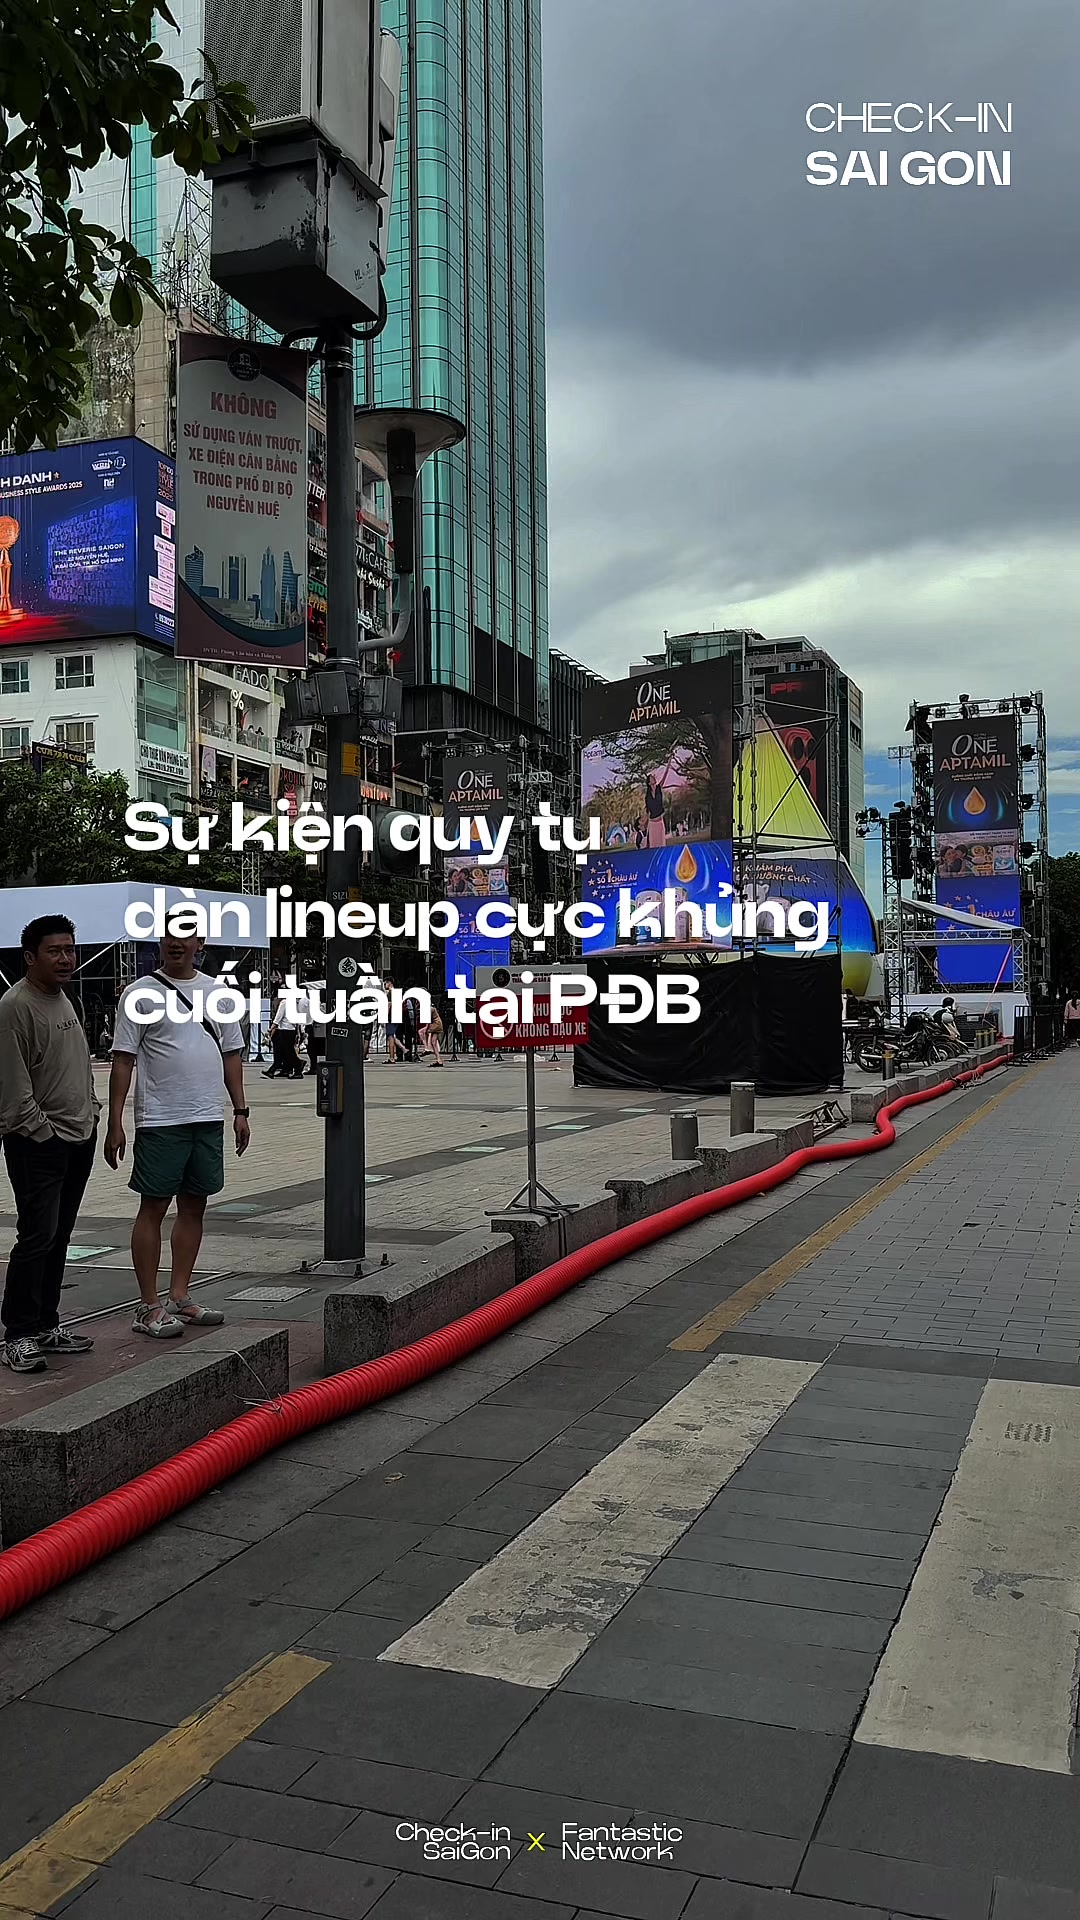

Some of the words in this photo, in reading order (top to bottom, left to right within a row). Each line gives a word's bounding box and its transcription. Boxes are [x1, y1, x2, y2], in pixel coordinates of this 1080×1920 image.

[211, 392, 277, 420] KHÔNG
[183, 420, 201, 439] SỬ
[202, 426, 235, 445] DỤNG
[238, 430, 262, 448] VÁN
[265, 435, 302, 455] TRƯỢT,
[188, 446, 204, 462] XE
[207, 448, 235, 468] ĐIỆN
[238, 452, 263, 470] CÂN
[266, 454, 298, 475] BẰNG
[12, 471, 52, 487] DANH
[25, 486, 42, 495] STYLE
[42, 482, 68, 493] AWARDS
[68, 480, 83, 489] 2025
[192, 470, 232, 489] TRONG
[235, 474, 260, 492] PHỐ
[262, 480, 274, 494] ĐI
[277, 480, 293, 499] BỘ
[206, 494, 254, 514] NGUYỄN
[257, 501, 280, 520] HUỆ
[98, 543, 125, 551] SAIGON
[637, 681, 671, 708] ONE
[628, 700, 681, 724] APTAMIL
[952, 734, 998, 756] ONE
[939, 754, 1012, 772] APTAMIL
[457, 769, 494, 790] ONE
[448, 788, 504, 803] APTAMIL
[975, 909, 1001, 919] CHÂU
[574, 1021, 587, 1036] XE
